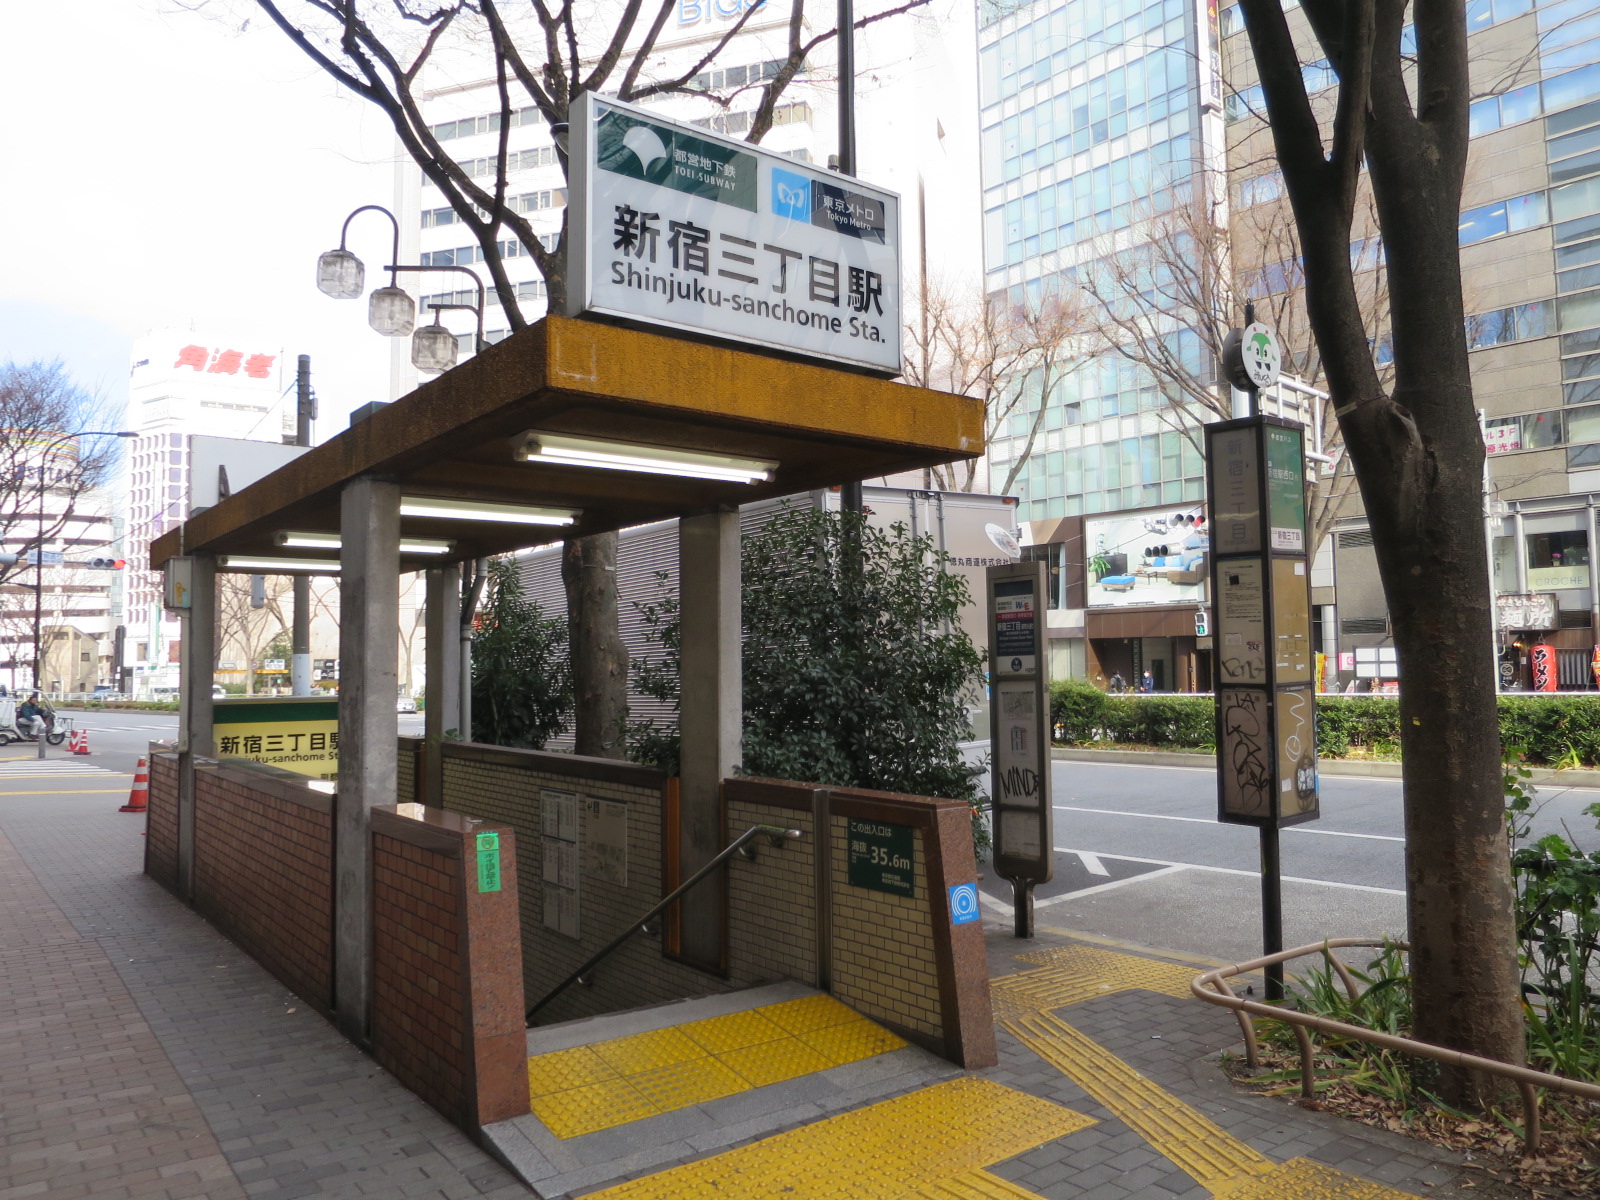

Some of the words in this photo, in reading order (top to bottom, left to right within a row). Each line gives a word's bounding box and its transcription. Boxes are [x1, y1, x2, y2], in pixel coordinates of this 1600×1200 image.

[674, 149, 736, 178] 都営地下鉄
[675, 165, 695, 179] TOEI
[698, 172, 736, 191] SUBWAY
[823, 195, 874, 221] 東京メトロ
[826, 210, 848, 224] Tokyo
[849, 217, 871, 231] Metro
[612, 203, 884, 318] 新宿三丁目駅
[611, 261, 842, 334] Shinjuku-sanchome
[849, 316, 887, 344] Sta.
[174, 344, 277, 379] 角海老
[1227, 440, 1247, 540] 新宿三丁目
[1535, 576, 1583, 587] CROCHE
[1533, 648, 1548, 691] ラーメン
[850, 822, 893, 837] この出入口は
[851, 840, 867, 854] 海抜
[870, 846, 911, 871] 35.6m
